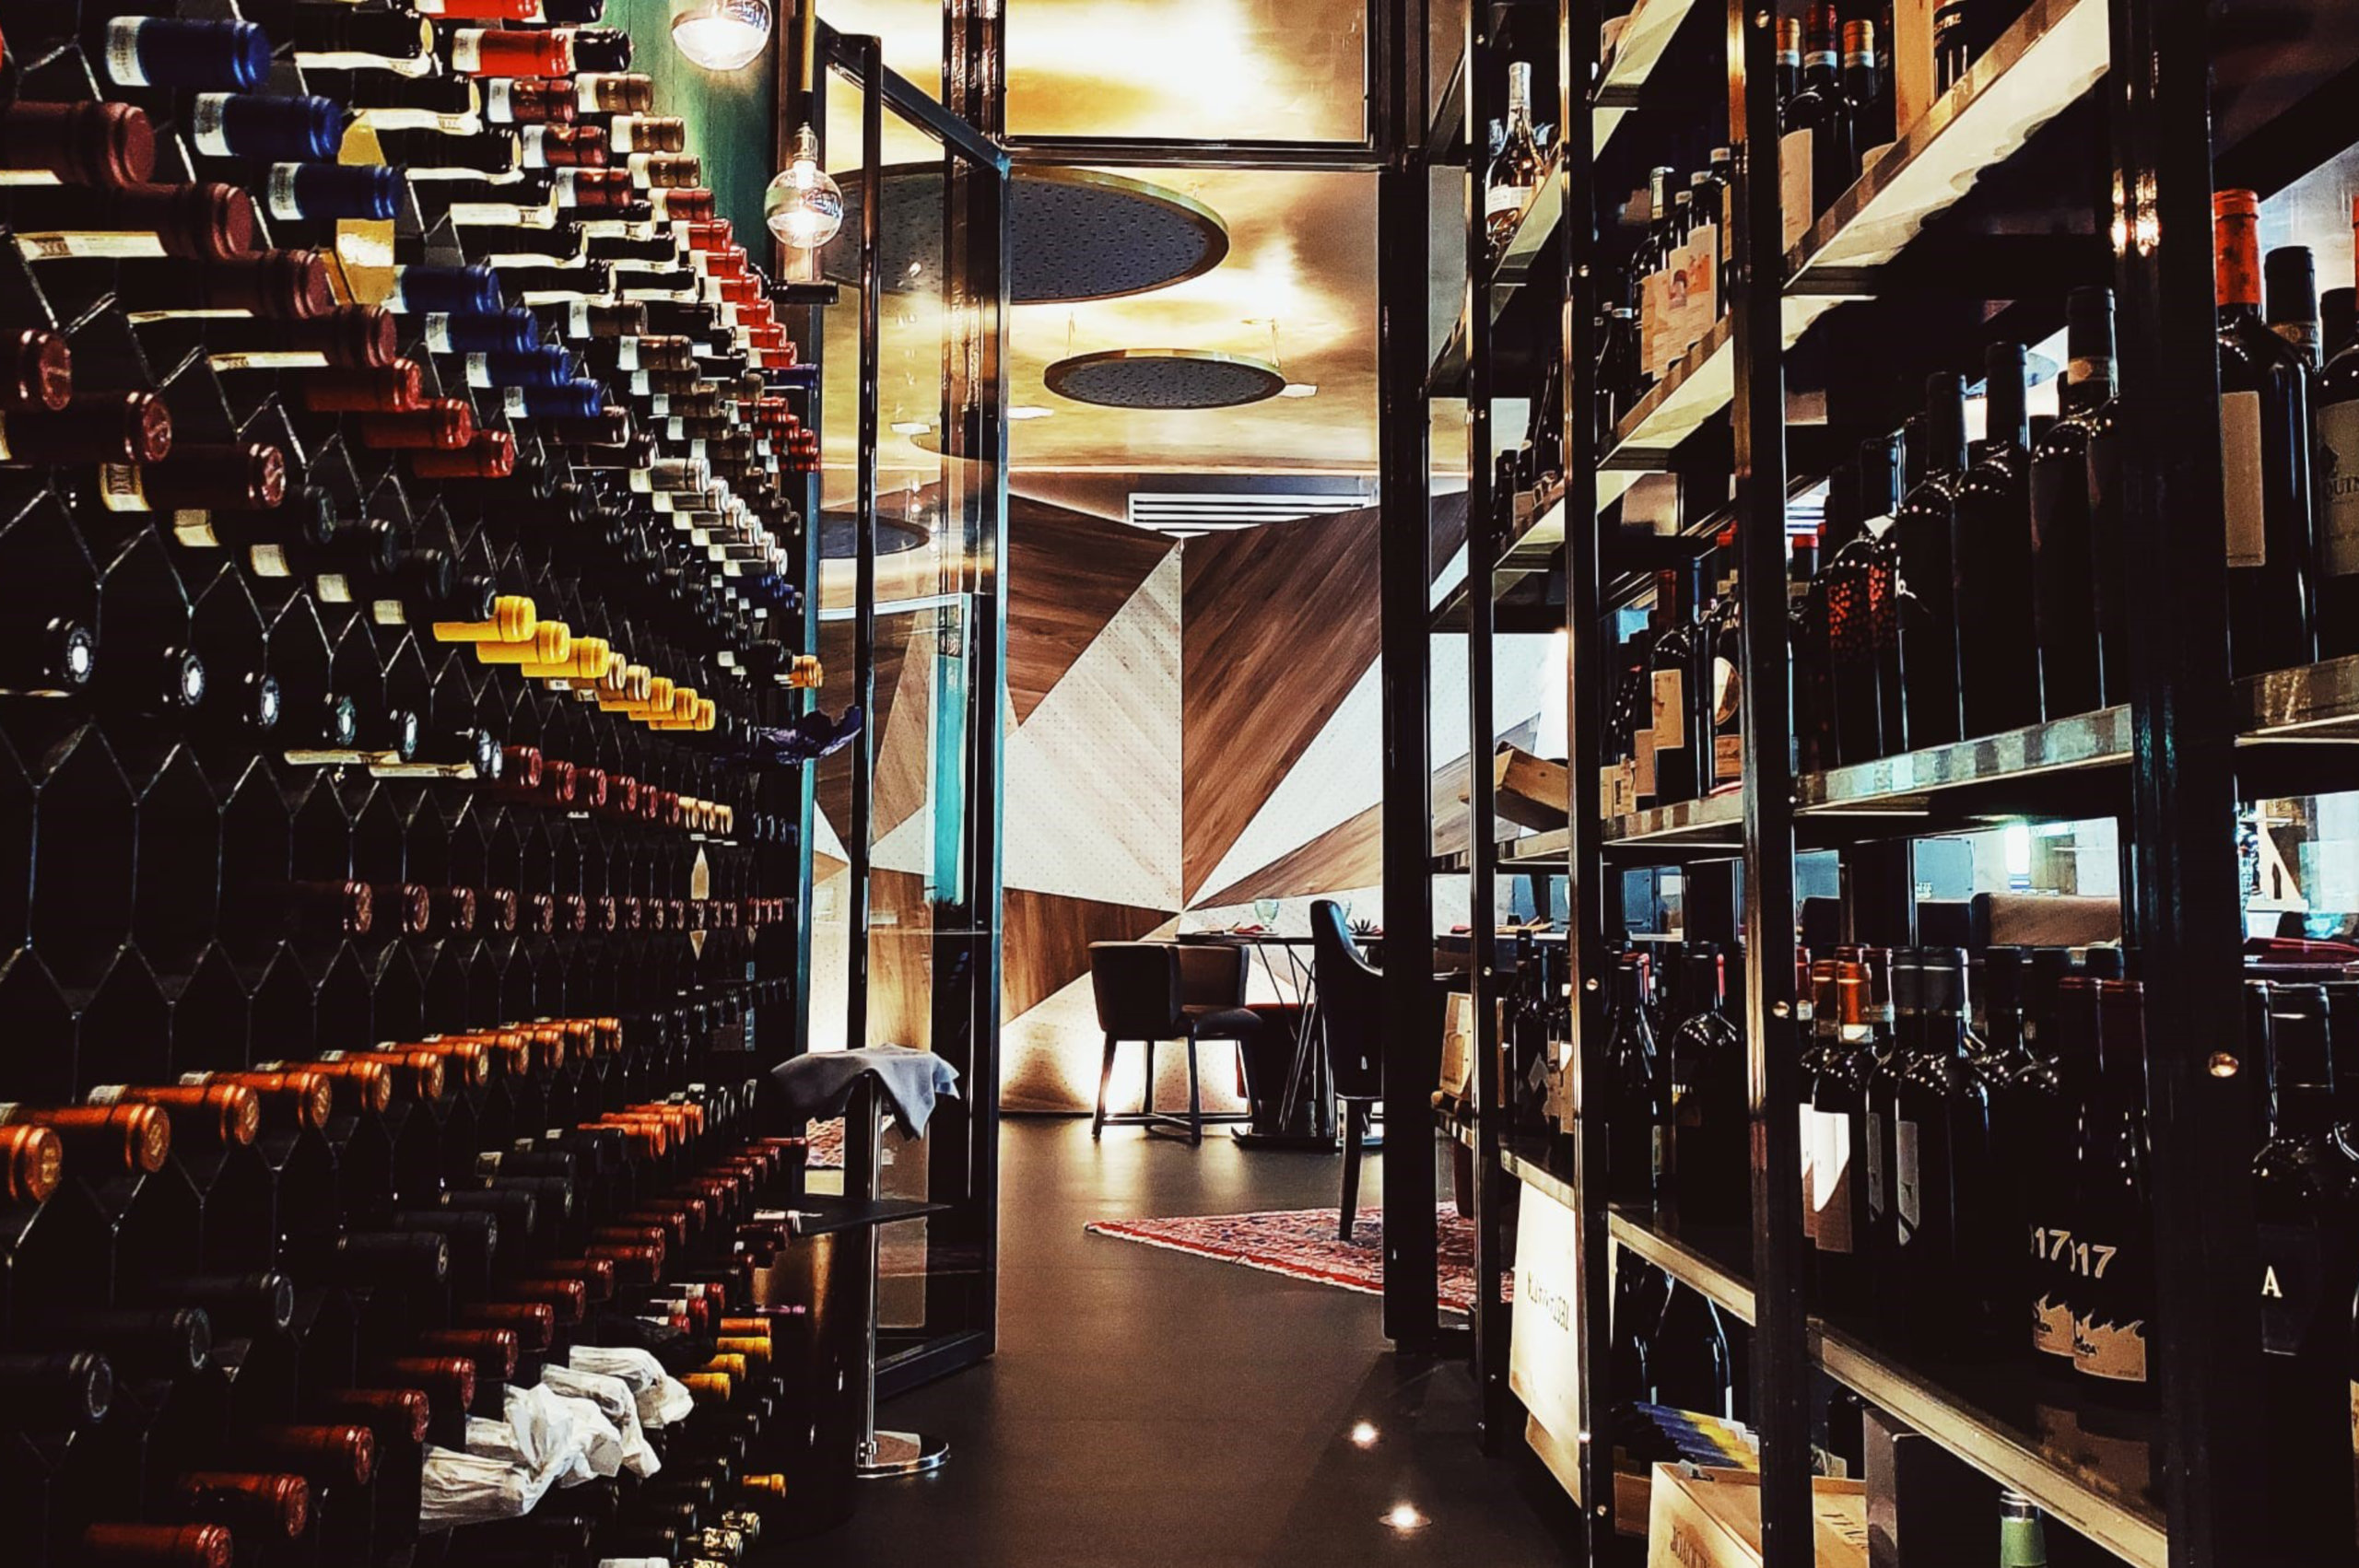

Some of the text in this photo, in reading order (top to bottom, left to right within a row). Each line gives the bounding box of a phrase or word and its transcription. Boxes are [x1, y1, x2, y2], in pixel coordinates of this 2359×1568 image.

[2030, 1224, 2071, 1260] 17
[2070, 1239, 2117, 1278] 17
[2261, 1265, 2283, 1298] A
